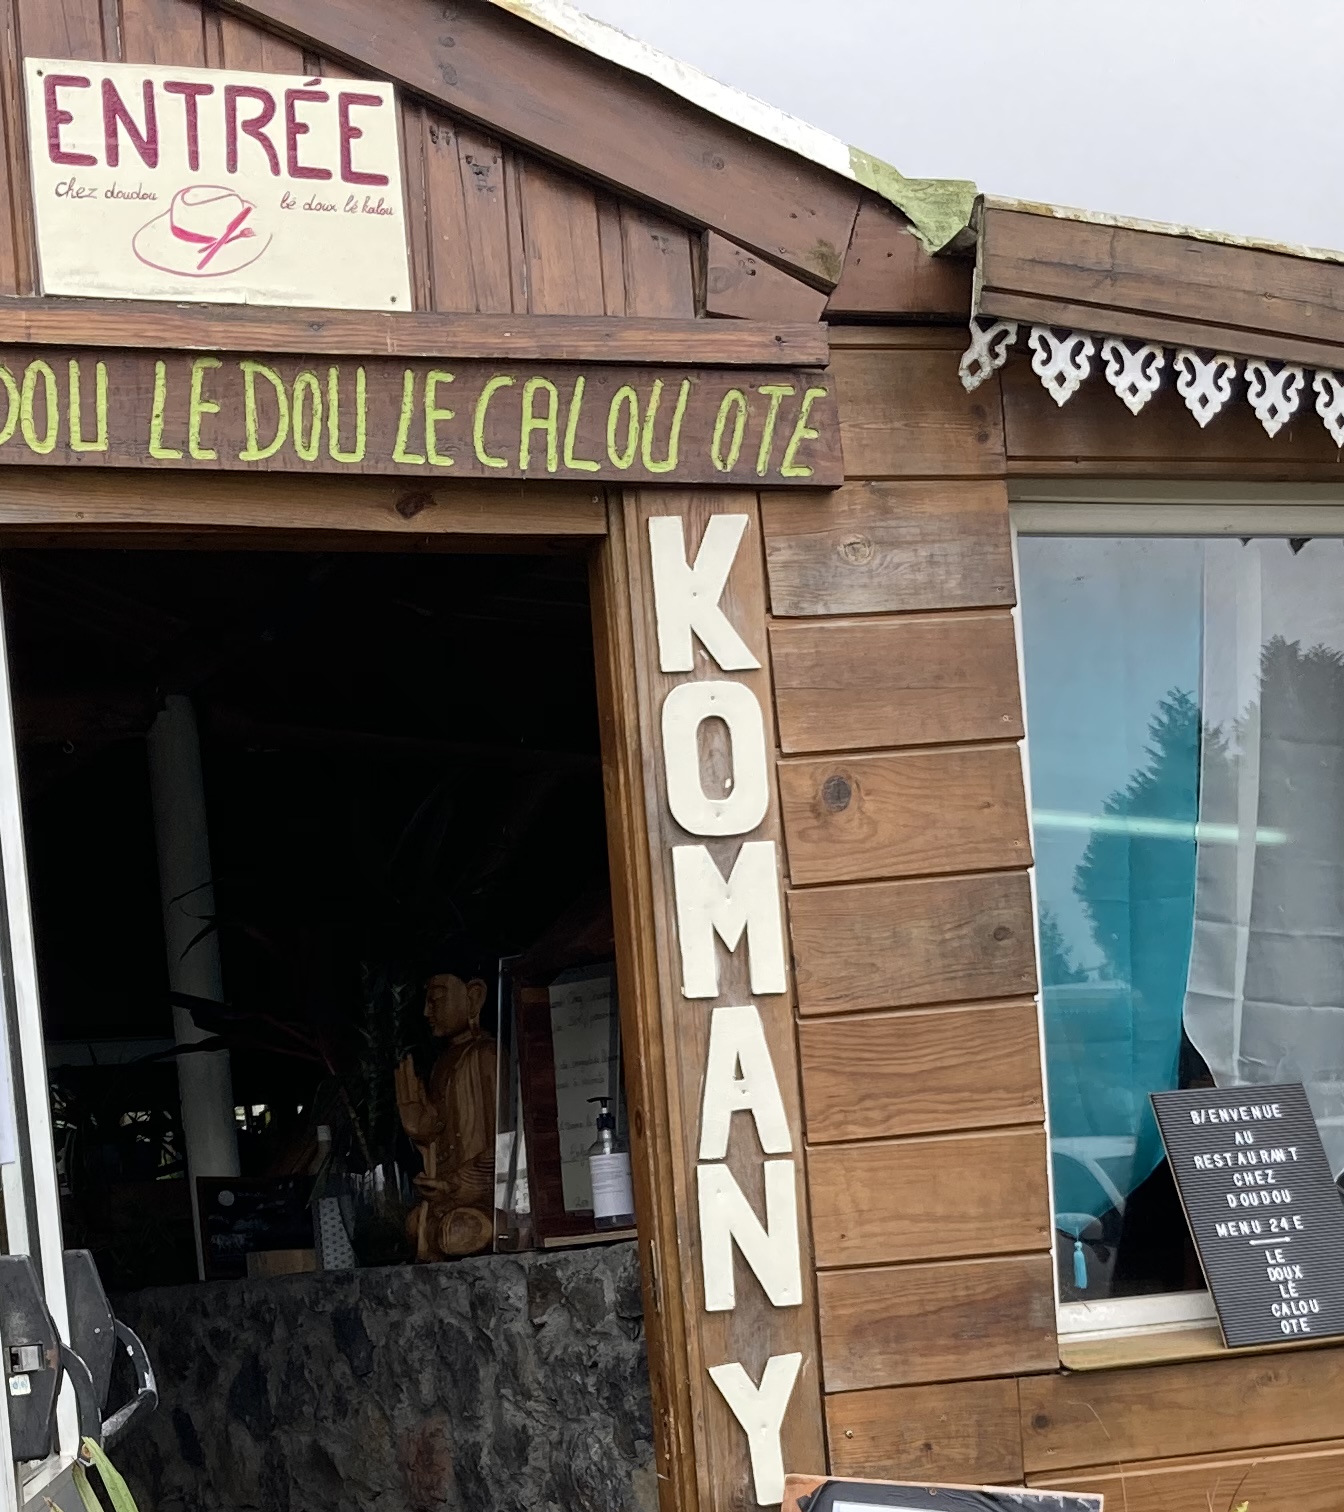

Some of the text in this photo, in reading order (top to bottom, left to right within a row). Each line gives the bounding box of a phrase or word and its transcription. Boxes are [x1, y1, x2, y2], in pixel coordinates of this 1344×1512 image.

[43, 74, 390, 187] ENTRÉE
[105, 181, 158, 200] doudou
[303, 194, 338, 212] doux
[150, 356, 222, 461] LE
[239, 358, 366, 463] DOU
[392, 368, 456, 467] LE
[473, 374, 691, 473] CALOU
[711, 384, 828, 478] OTE
[1190, 1104, 1282, 1125] BIENVENUE
[1235, 1130, 1254, 1145] AU
[1194, 1147, 1298, 1170] RESTAURANT
[1233, 1169, 1276, 1187] CHEZ
[1226, 1189, 1292, 1208] DOUDOU
[1215, 1220, 1262, 1237] MENU
[1265, 1249, 1286, 1264] LE
[1267, 1264, 1304, 1282] DOUX
[1271, 1299, 1320, 1317] CALOU
[1280, 1317, 1311, 1334] OTE
